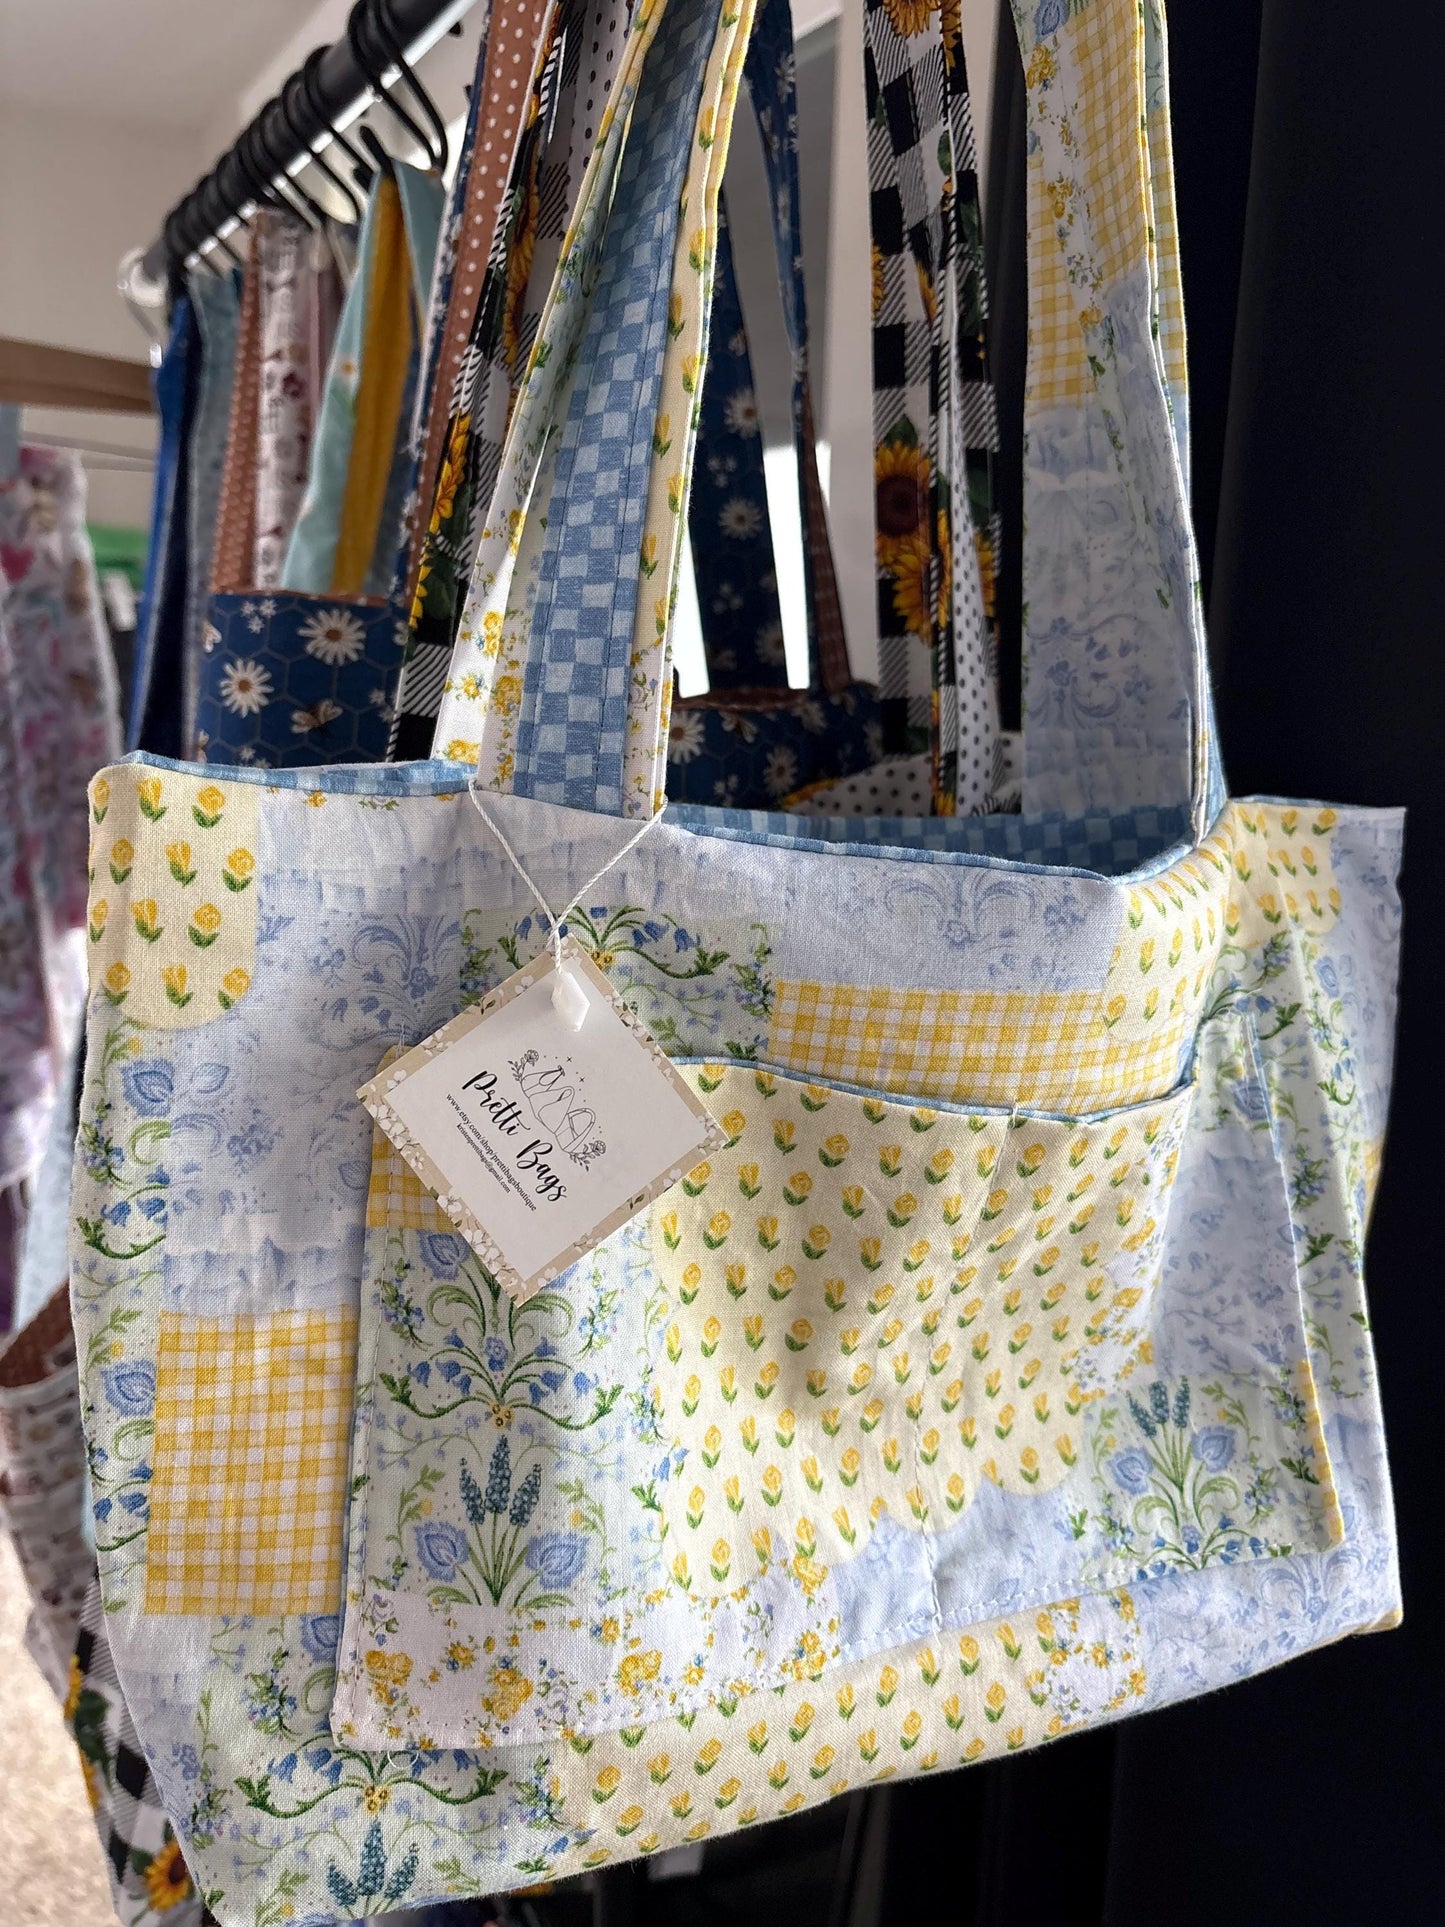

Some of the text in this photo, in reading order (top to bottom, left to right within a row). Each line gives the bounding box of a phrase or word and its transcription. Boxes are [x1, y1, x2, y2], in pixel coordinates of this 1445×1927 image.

[446, 1094, 537, 1211] www.etsy.com/shop/prettibagsboutique
[462, 1071, 567, 1201] Pretti Bags
